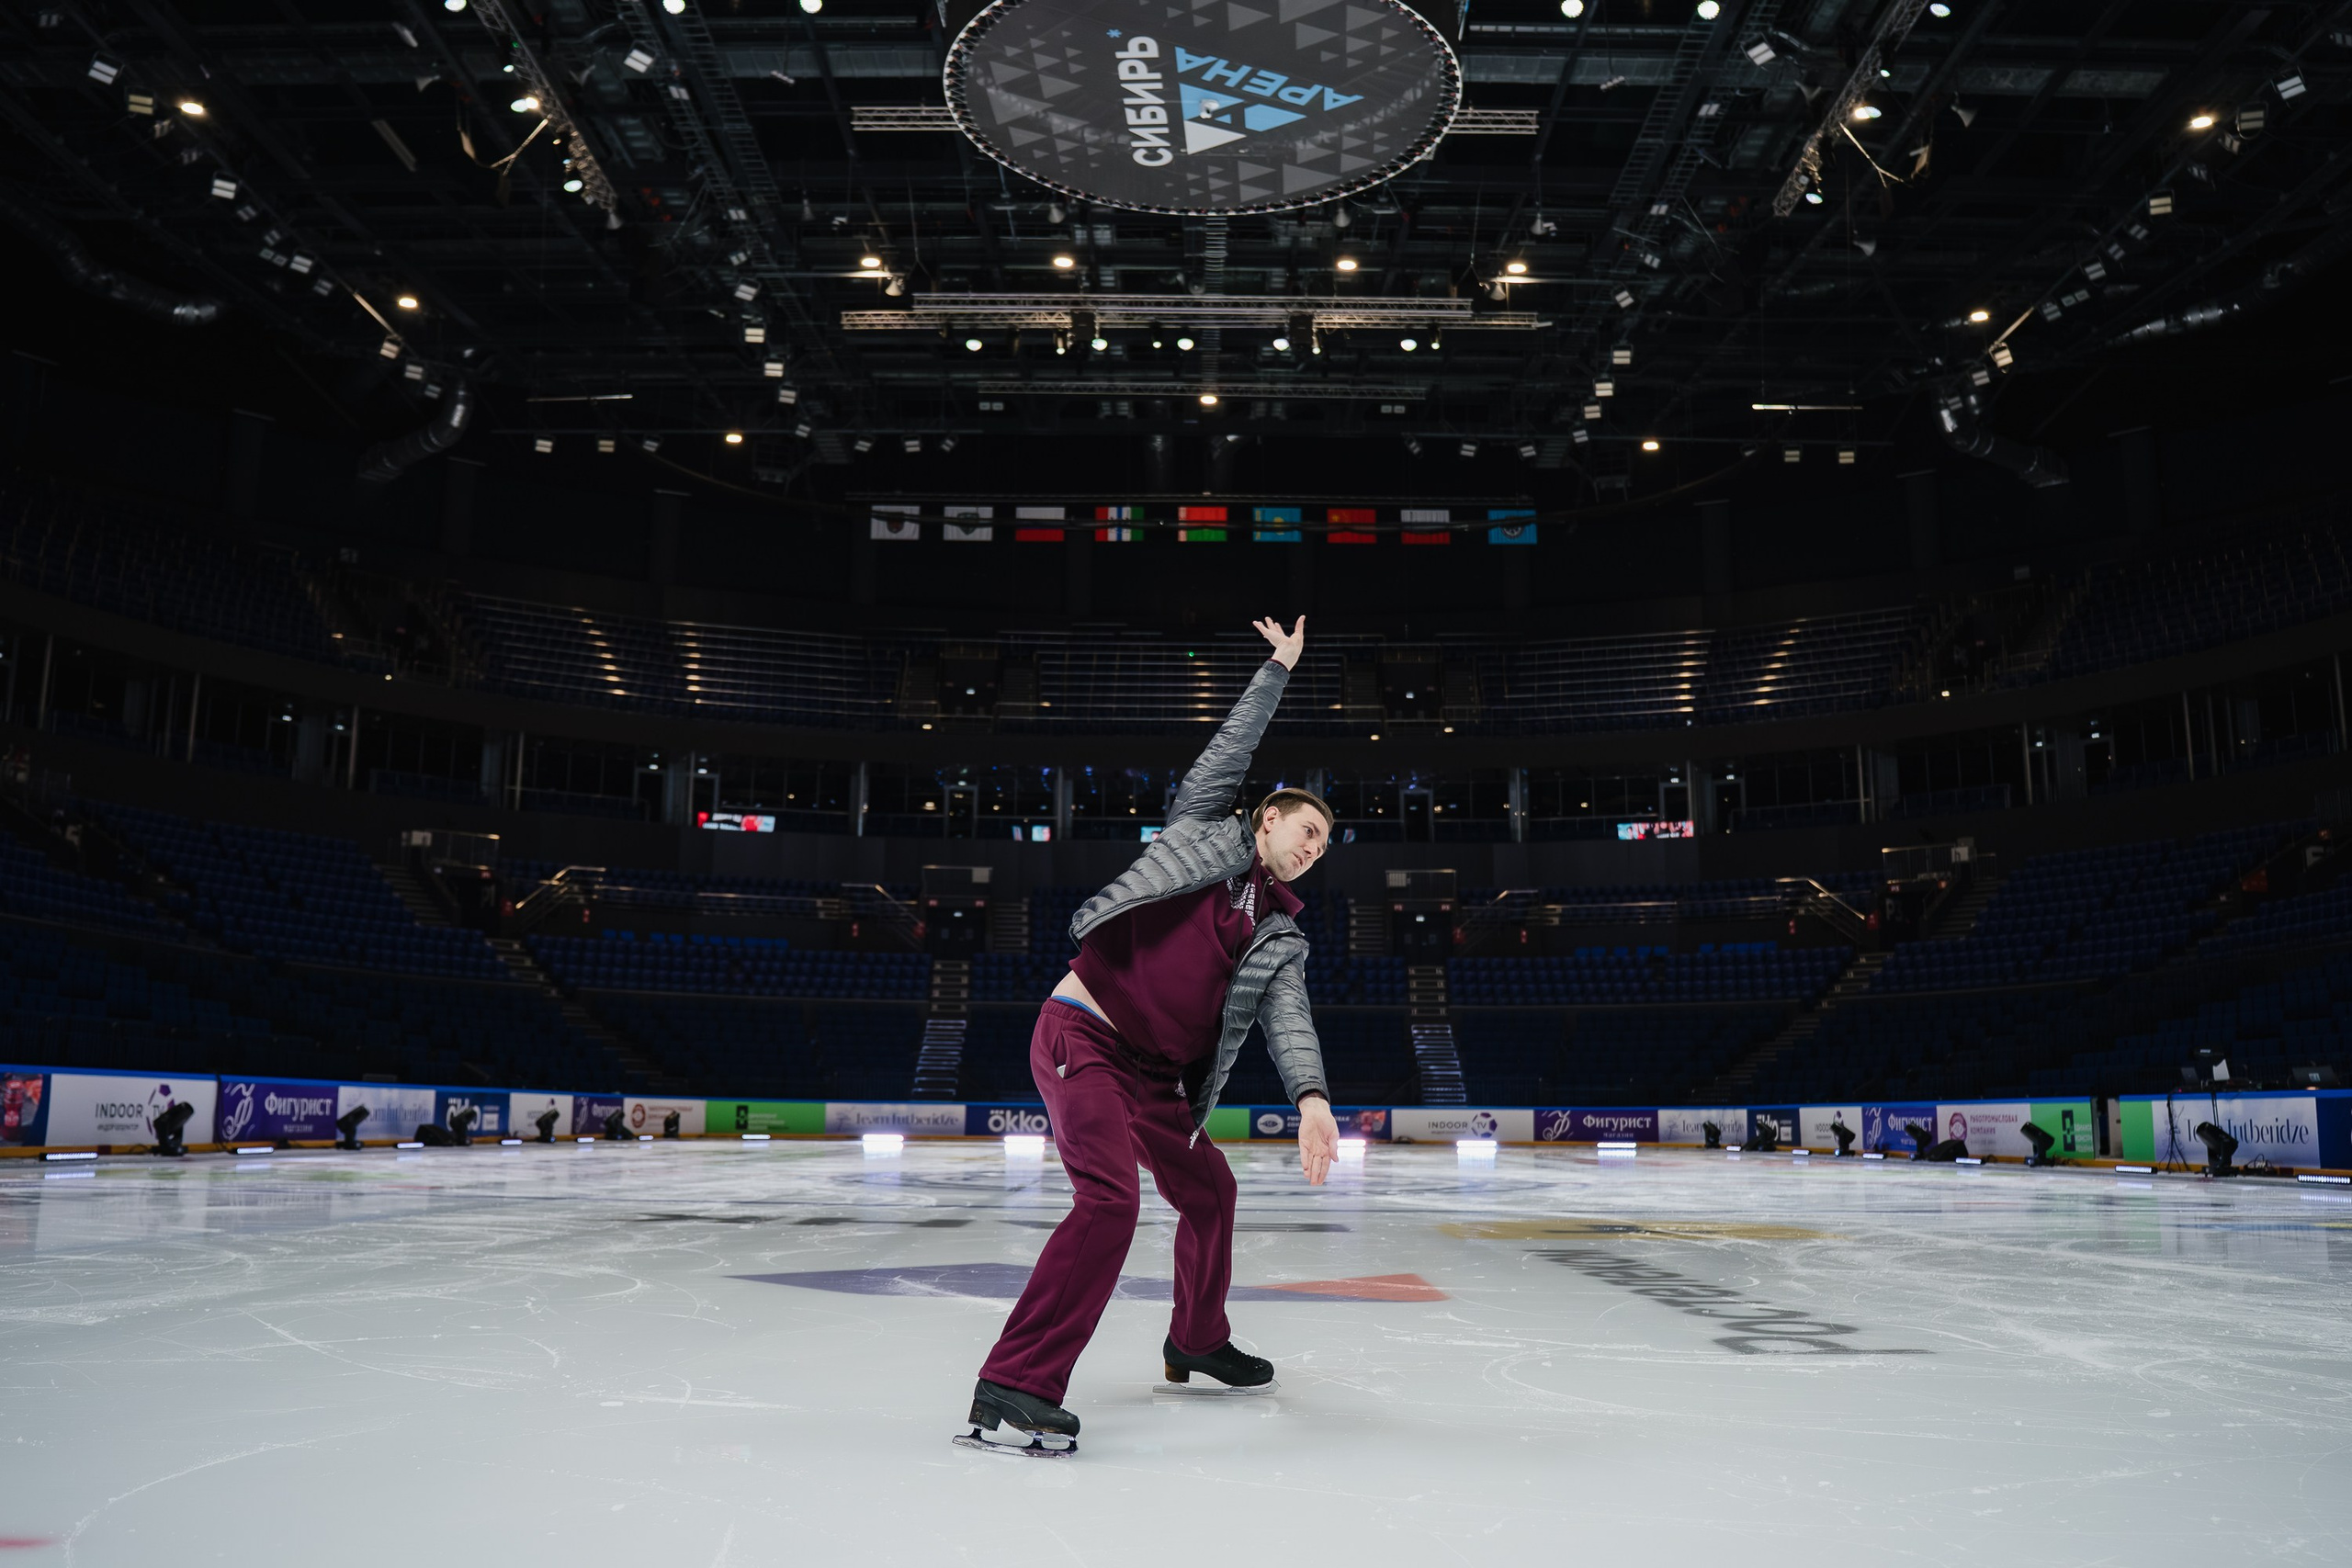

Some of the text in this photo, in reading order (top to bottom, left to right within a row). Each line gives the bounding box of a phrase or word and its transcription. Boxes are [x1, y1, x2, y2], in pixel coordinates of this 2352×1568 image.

[1174, 46, 1365, 112] АРЕНА
[1114, 35, 1174, 168] СИБИРЬ
[95, 1103, 143, 1118] INDOOR
[265, 1091, 333, 1122] Фигурист
[1428, 1121, 1468, 1129] INDOOR
[1582, 1114, 1652, 1131] Фигурист
